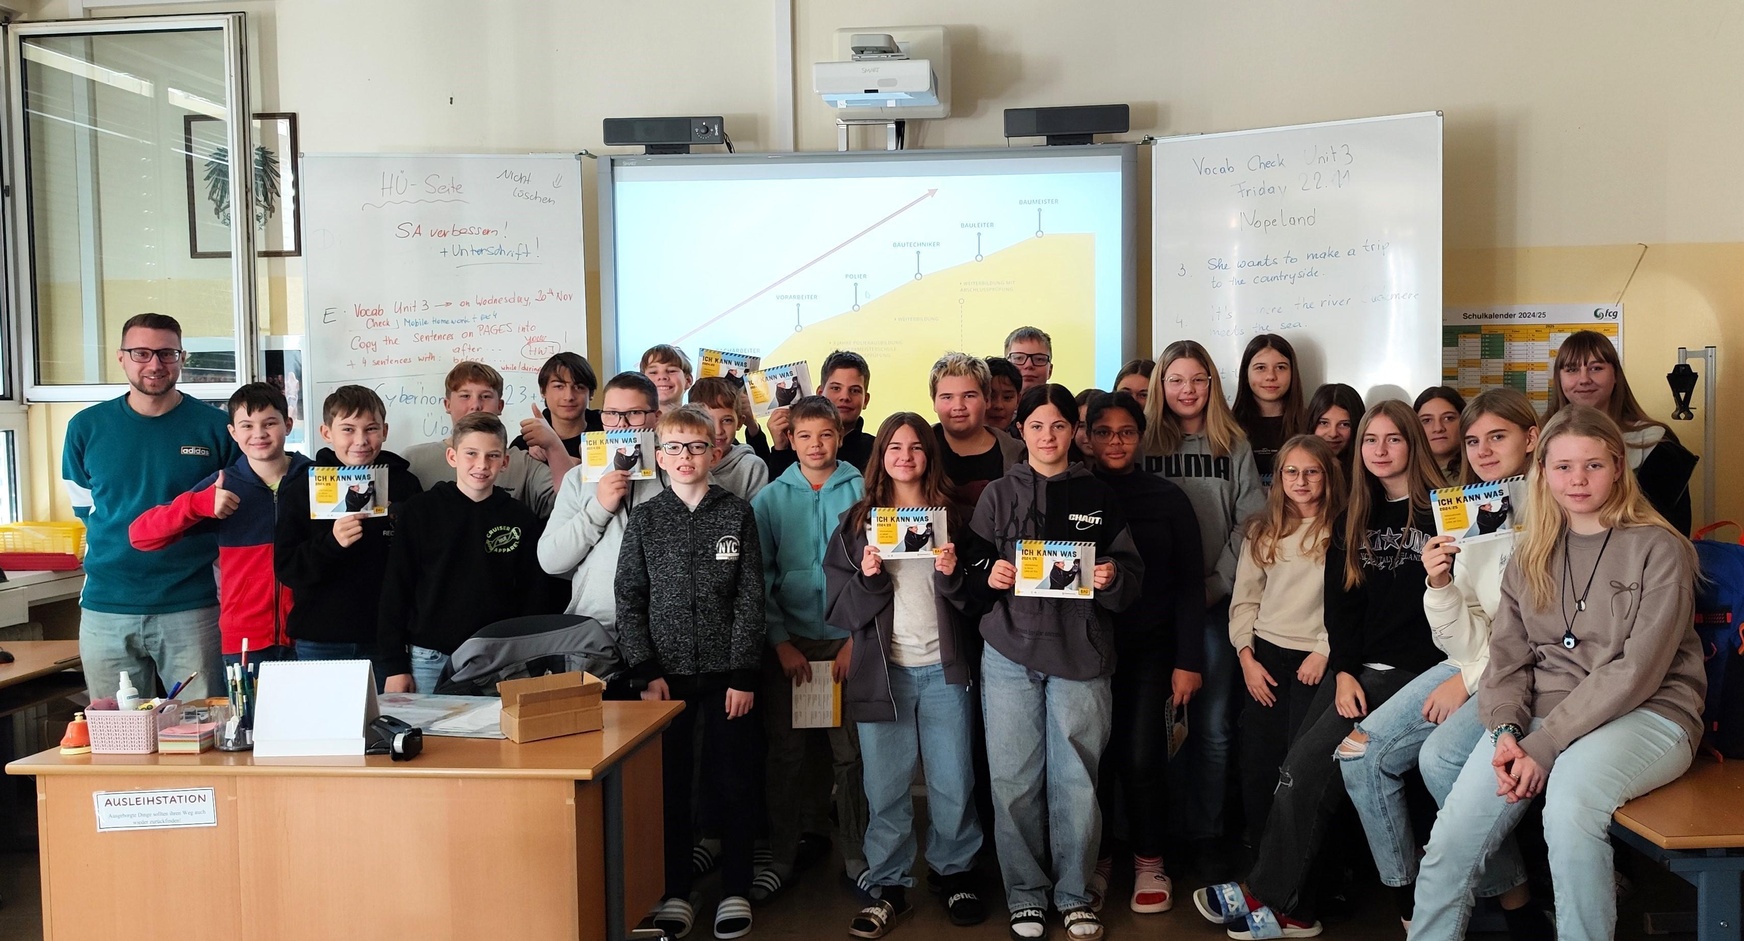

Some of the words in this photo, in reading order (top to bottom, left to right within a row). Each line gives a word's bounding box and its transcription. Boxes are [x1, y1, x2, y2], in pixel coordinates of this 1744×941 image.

[1192, 157, 1235, 176] Vocab
[1247, 153, 1287, 172] Check
[1341, 144, 1354, 165] 3
[395, 221, 422, 239] SA
[1207, 257, 1231, 271] She
[1236, 254, 1279, 269] wants
[1282, 250, 1298, 264] to
[1306, 246, 1341, 260] make
[1347, 248, 1356, 257] a
[1362, 239, 1390, 257] trip
[1211, 276, 1223, 289] to
[354, 303, 384, 318] Vocab
[393, 300, 417, 315] Unit
[421, 299, 430, 312] 3
[459, 300, 470, 308] on
[556, 290, 574, 302] Nov
[1320, 294, 1352, 308] river
[1462, 312, 1517, 321] Schulkalender
[1518, 311, 1547, 320] 2024/25
[350, 335, 378, 354] Copy
[383, 335, 401, 345] the
[461, 331, 474, 340] on
[477, 322, 513, 337] PAGES
[702, 355, 713, 363] ICH
[715, 357, 732, 366] KANN
[734, 360, 748, 368] WAS
[182, 446, 210, 455] adidas
[1438, 498, 1453, 506] ICH
[1456, 494, 1481, 504] KANN
[1483, 489, 1504, 499] WAS
[486, 526, 511, 538] CRUISER
[719, 540, 738, 553] NYC
[1036, 549, 1058, 557] KANN
[104, 794, 207, 807] AUSLEIHSTATION
